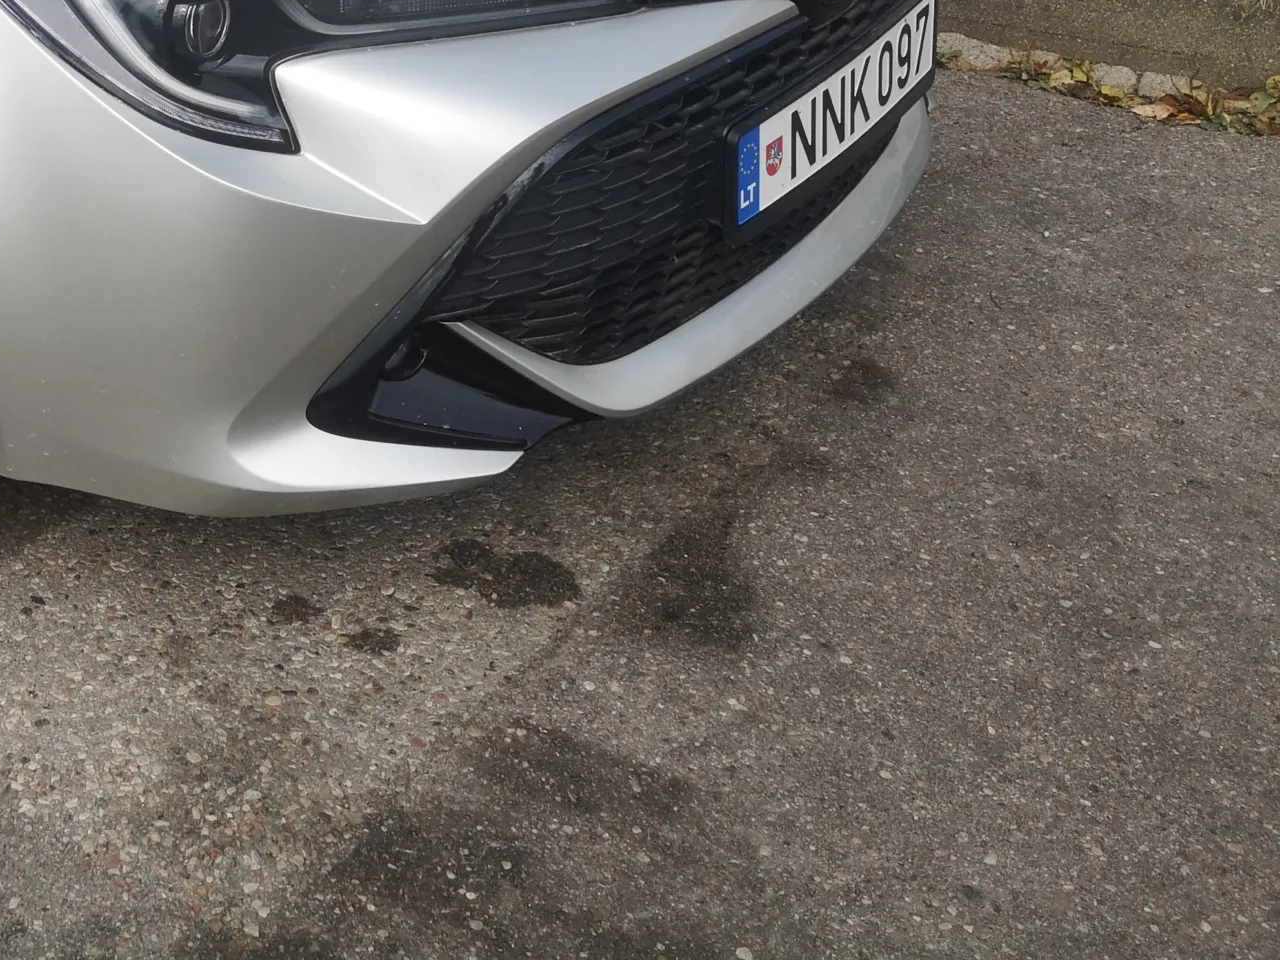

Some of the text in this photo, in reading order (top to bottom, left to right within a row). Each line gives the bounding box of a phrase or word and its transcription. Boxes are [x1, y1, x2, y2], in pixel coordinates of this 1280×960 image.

[790, 3, 930, 181] NNK 097
[740, 181, 757, 210] LT
